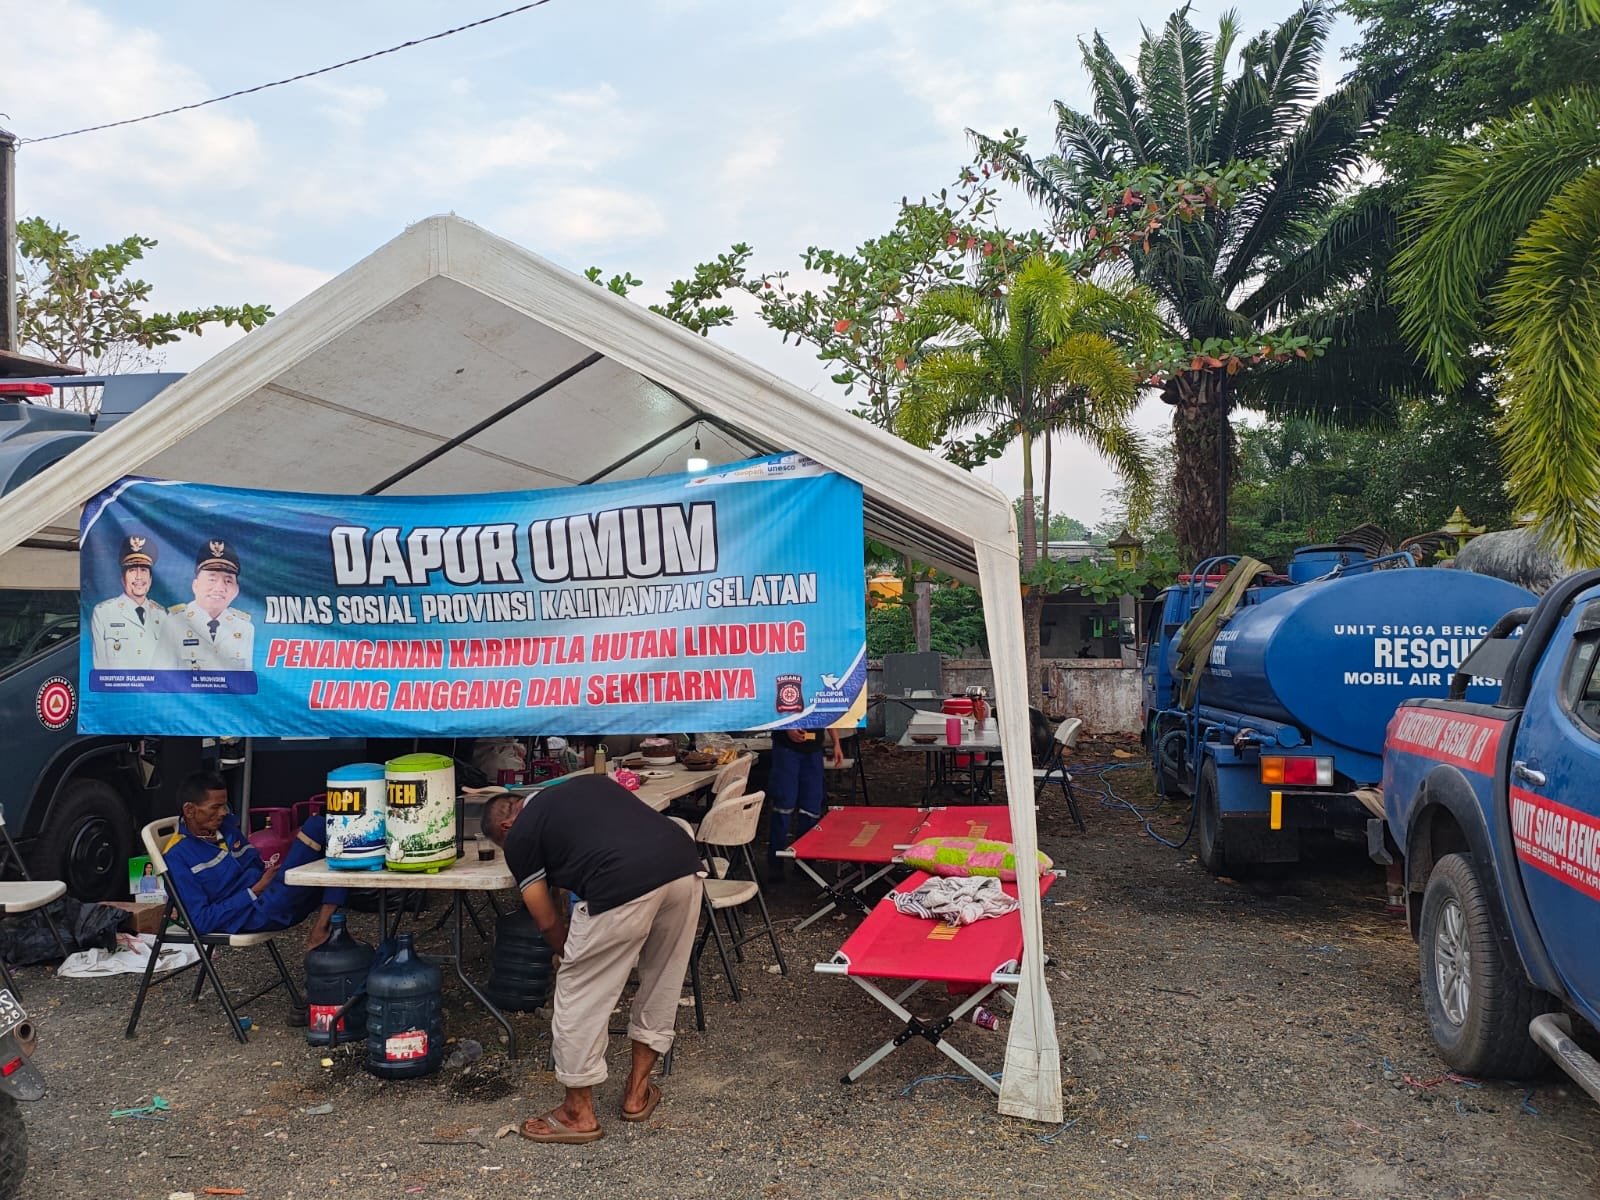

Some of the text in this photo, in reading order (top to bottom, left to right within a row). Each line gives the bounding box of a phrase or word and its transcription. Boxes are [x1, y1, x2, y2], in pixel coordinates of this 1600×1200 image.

[767, 464, 796, 473] unesco
[331, 501, 718, 587] DAPUR UMUM
[264, 573, 817, 624] DINAS SOSIAL PROVINSI KALIMANTAN SELATAN
[266, 620, 807, 669] PENANGANAN KARHUTLA HUTAN LINDUNG
[1334, 625, 1524, 636] UNIT SIAGA BENCA
[309, 680, 390, 710] LIANG
[392, 677, 522, 711] ANGGANG
[525, 676, 583, 708] DAN
[586, 668, 756, 705] SEKITARNYA
[1344, 672, 1403, 686] MOBIL
[1408, 673, 1441, 686] AIR
[1439, 720, 1479, 758] SOSIAL
[1469, 727, 1493, 763] RI
[327, 790, 360, 812] KOPI
[389, 783, 417, 804] TEH
[1513, 798, 1536, 840] UNIT
[1535, 808, 1568, 857] SIAGA
[1560, 860, 1600, 891] PROV.KA
